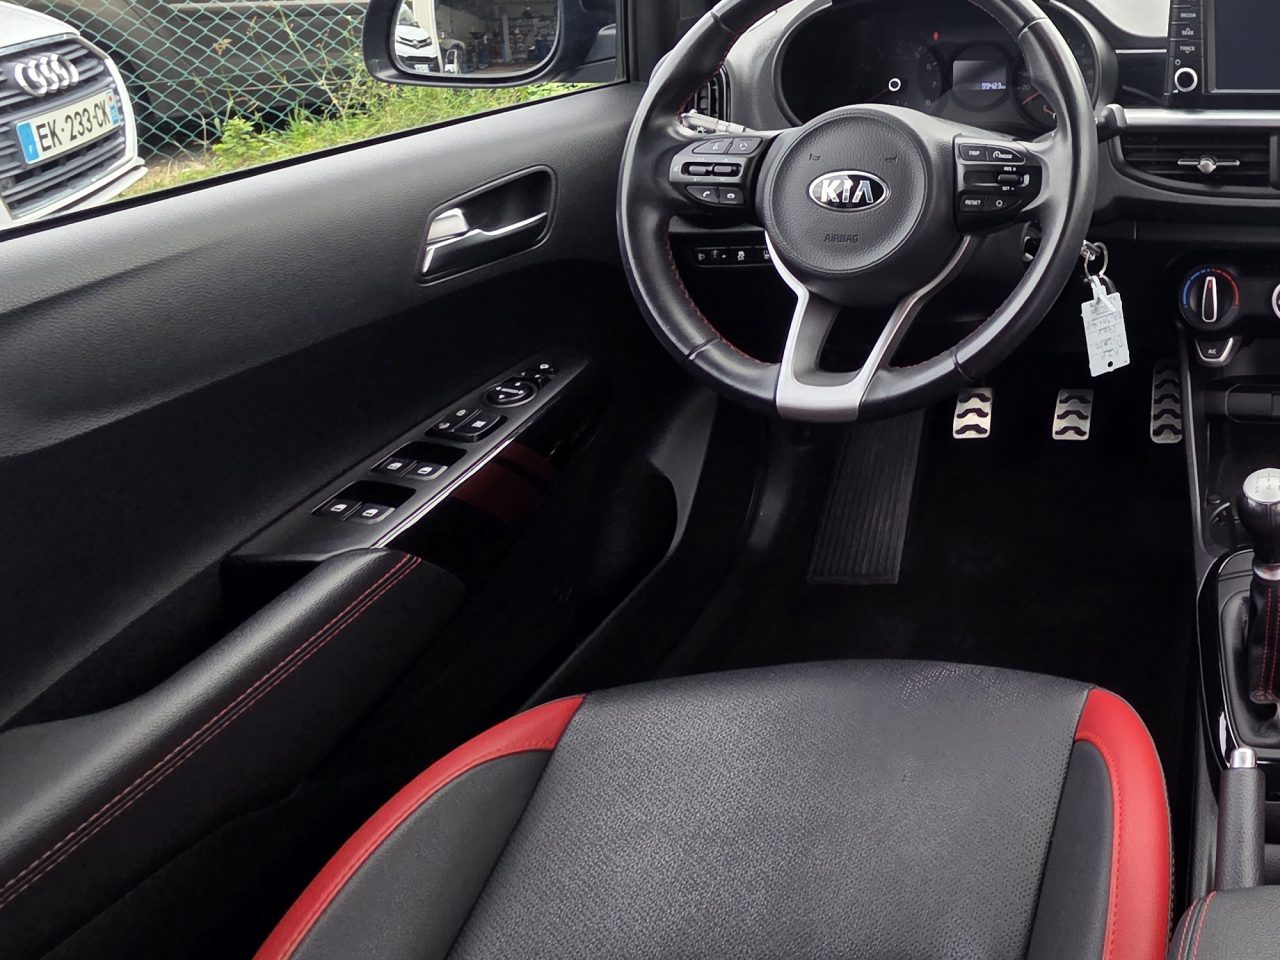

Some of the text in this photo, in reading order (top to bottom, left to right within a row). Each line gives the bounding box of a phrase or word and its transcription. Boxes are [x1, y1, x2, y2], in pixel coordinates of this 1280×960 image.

[35, 99, 111, 152] EK-233-CK
[820, 179, 874, 203] KIA
[823, 233, 859, 243] AIRBAG
